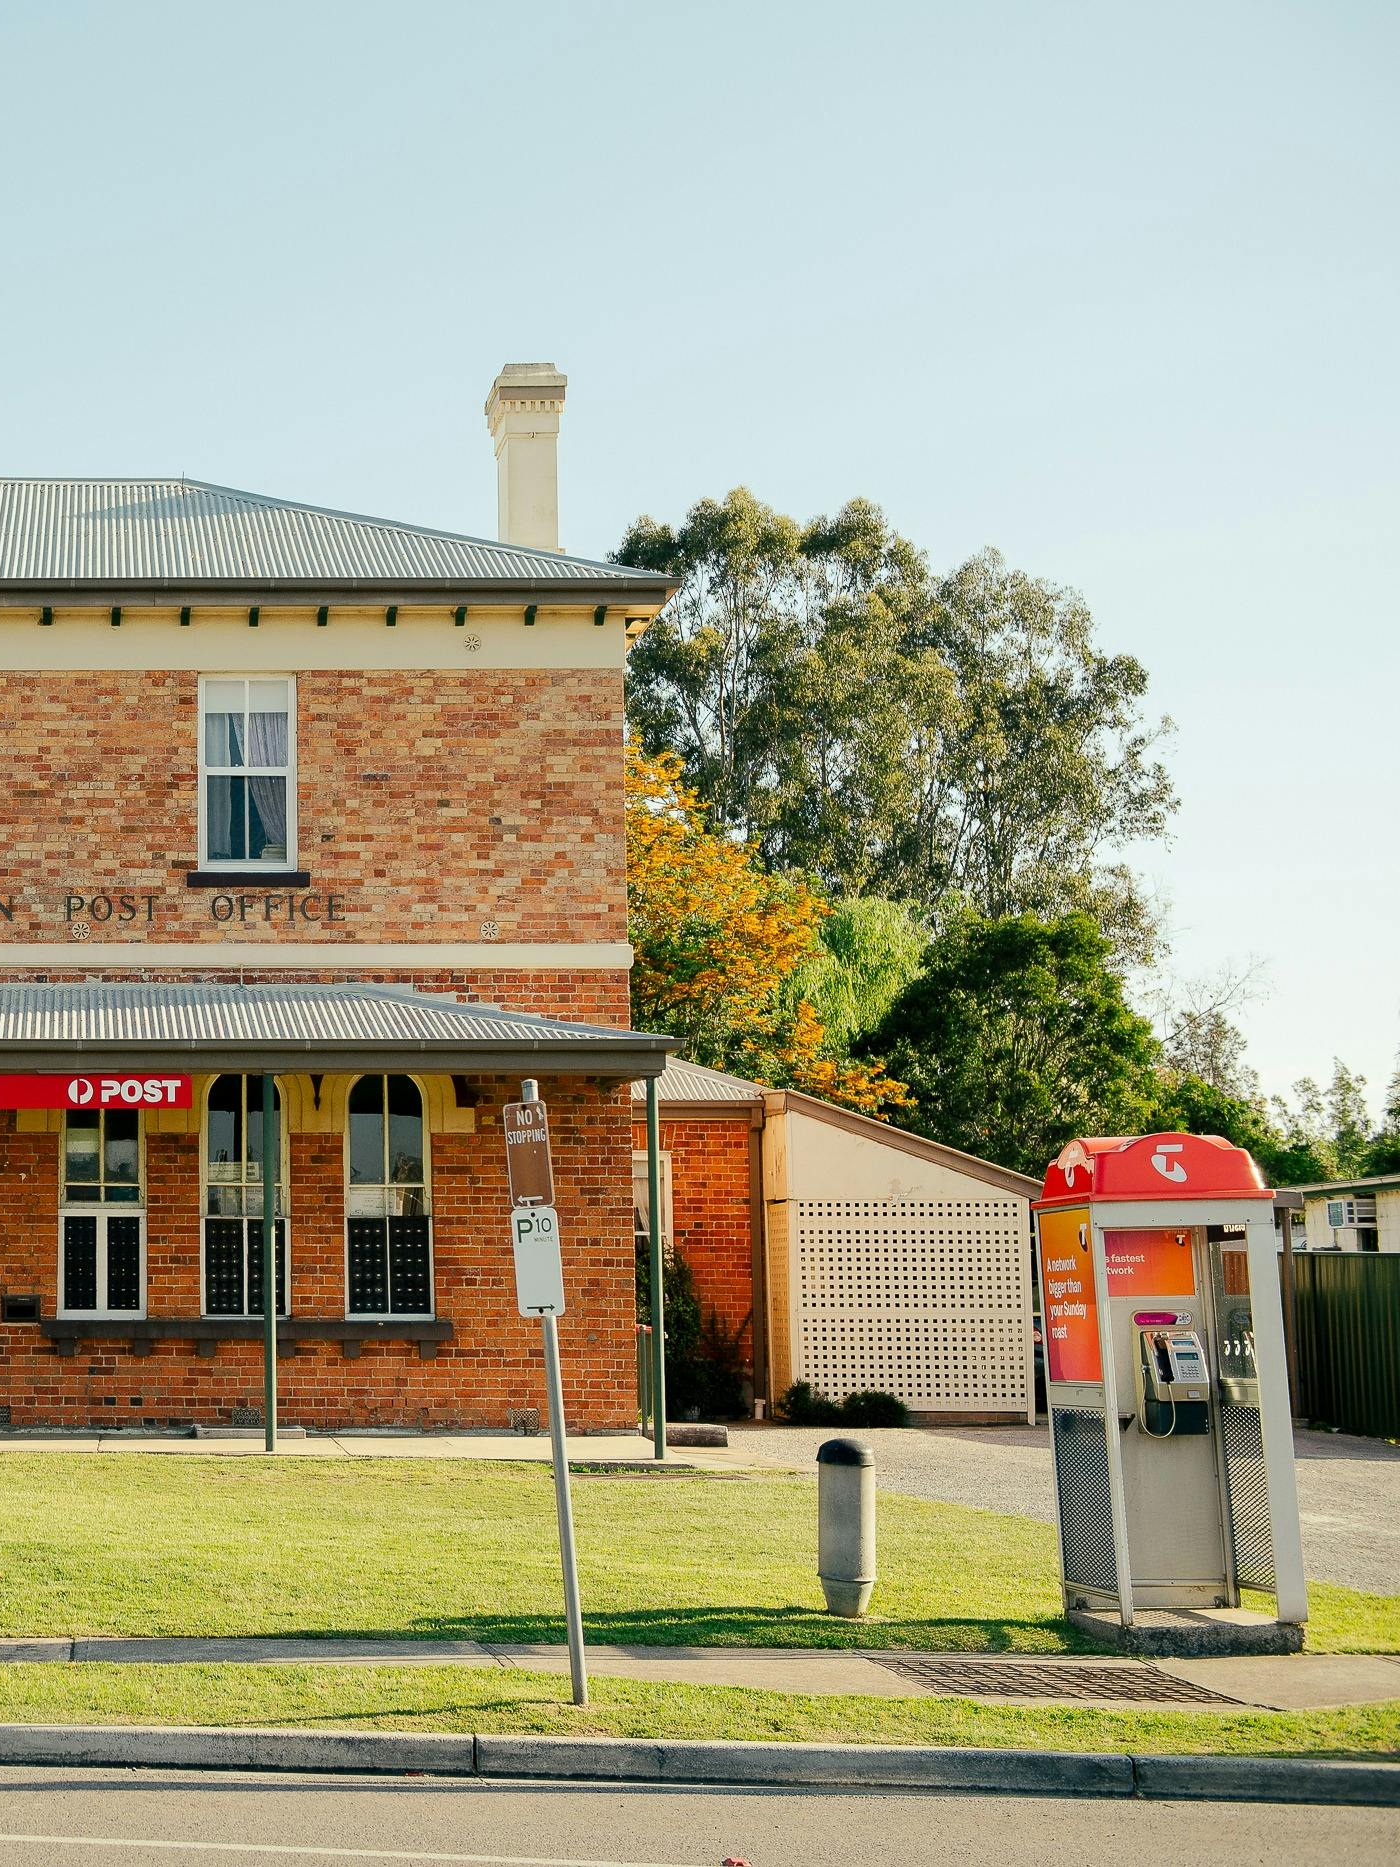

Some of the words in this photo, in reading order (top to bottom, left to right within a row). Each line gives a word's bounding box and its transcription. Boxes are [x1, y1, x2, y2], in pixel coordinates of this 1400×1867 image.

[65, 894, 159, 922] POST
[211, 893, 346, 922] OFFICE
[101, 1079, 182, 1103] POST
[516, 1109, 533, 1126] NO
[507, 1128, 546, 1145] STOPPING
[516, 1218, 533, 1244] P
[535, 1217, 552, 1233] 10
[1047, 1258, 1052, 1273] A
[1052, 1256, 1077, 1272] network
[1111, 1253, 1146, 1263] fastest
[1106, 1265, 1135, 1275] twork
[1048, 1279, 1067, 1299] bigger
[1067, 1277, 1082, 1293] than
[1050, 1303, 1064, 1320] your
[1064, 1300, 1087, 1320] Sunday
[1052, 1324, 1068, 1339] roast
